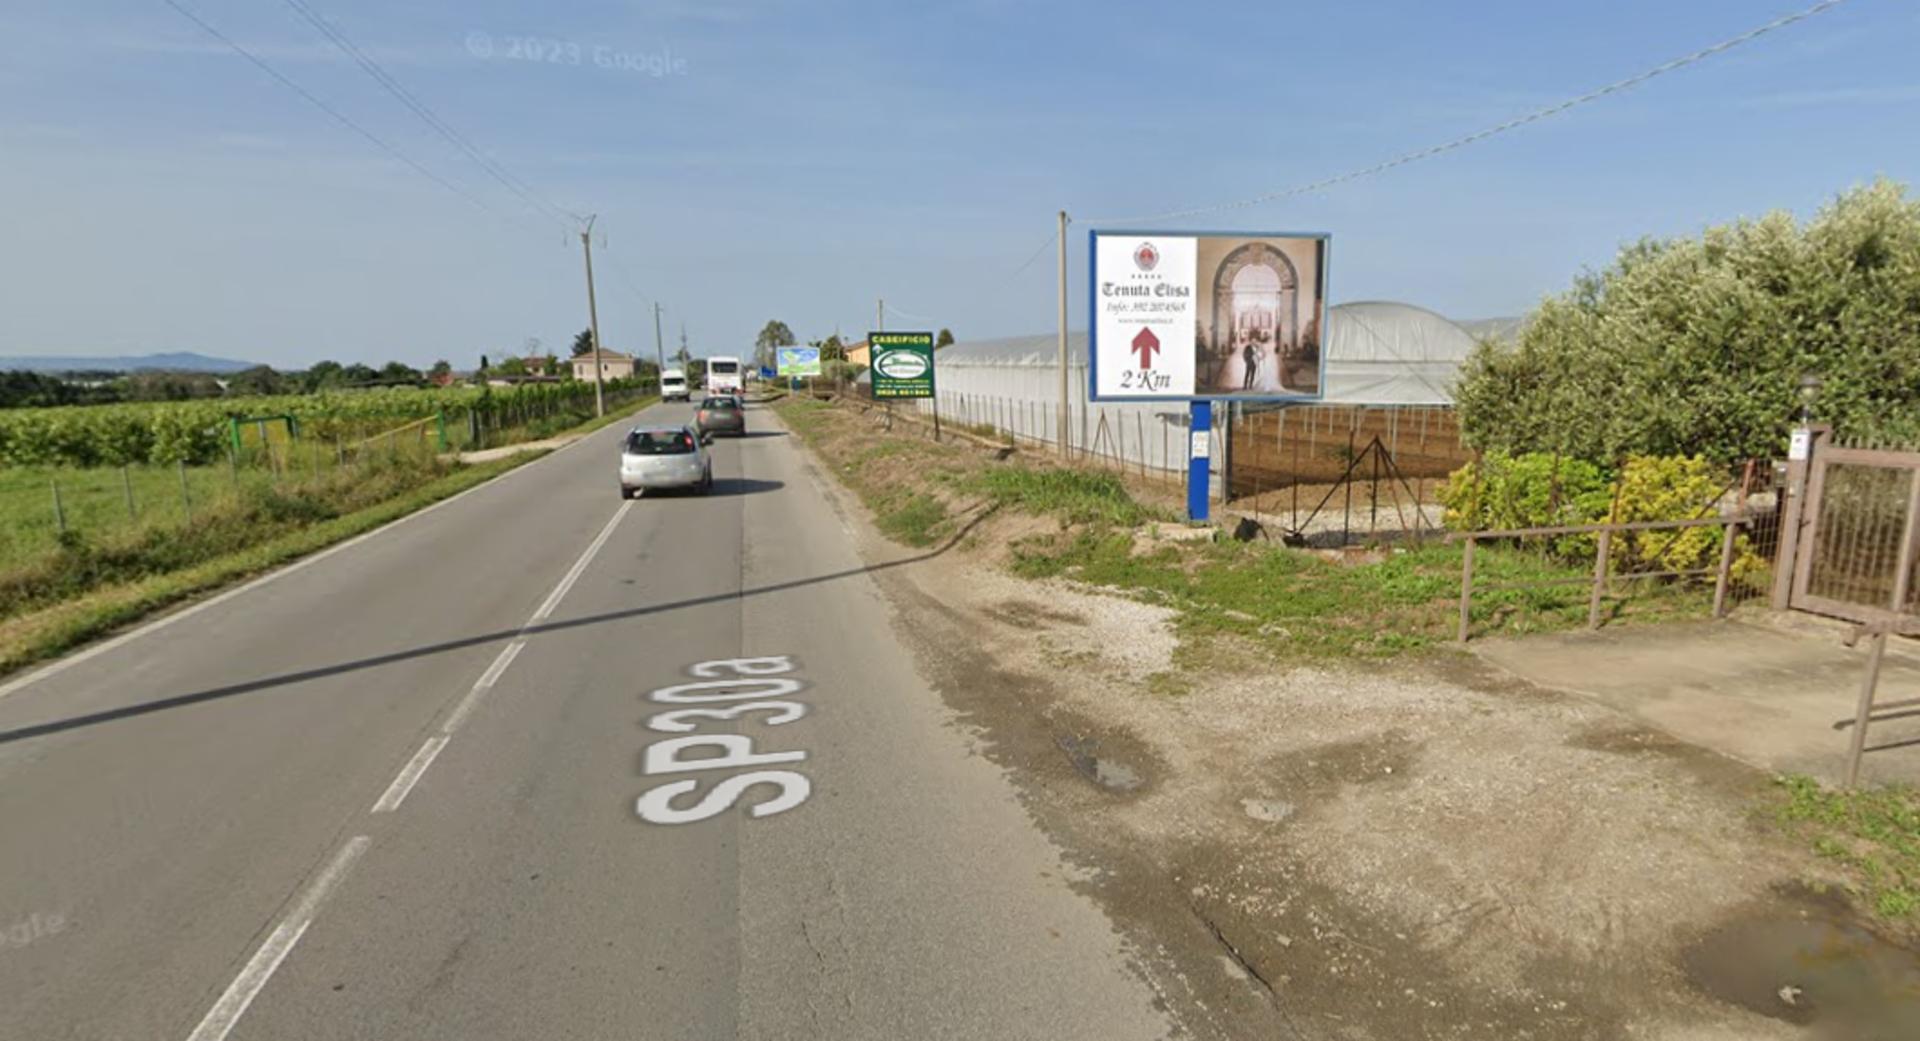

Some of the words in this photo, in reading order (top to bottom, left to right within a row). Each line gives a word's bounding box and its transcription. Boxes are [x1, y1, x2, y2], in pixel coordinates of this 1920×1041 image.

[1102, 281, 1150, 297] Tenuta
[1154, 283, 1190, 297] Elisa
[872, 335, 931, 344] CASEIFICIO
[1120, 369, 1133, 388] 2
[1137, 370, 1171, 391] Km
